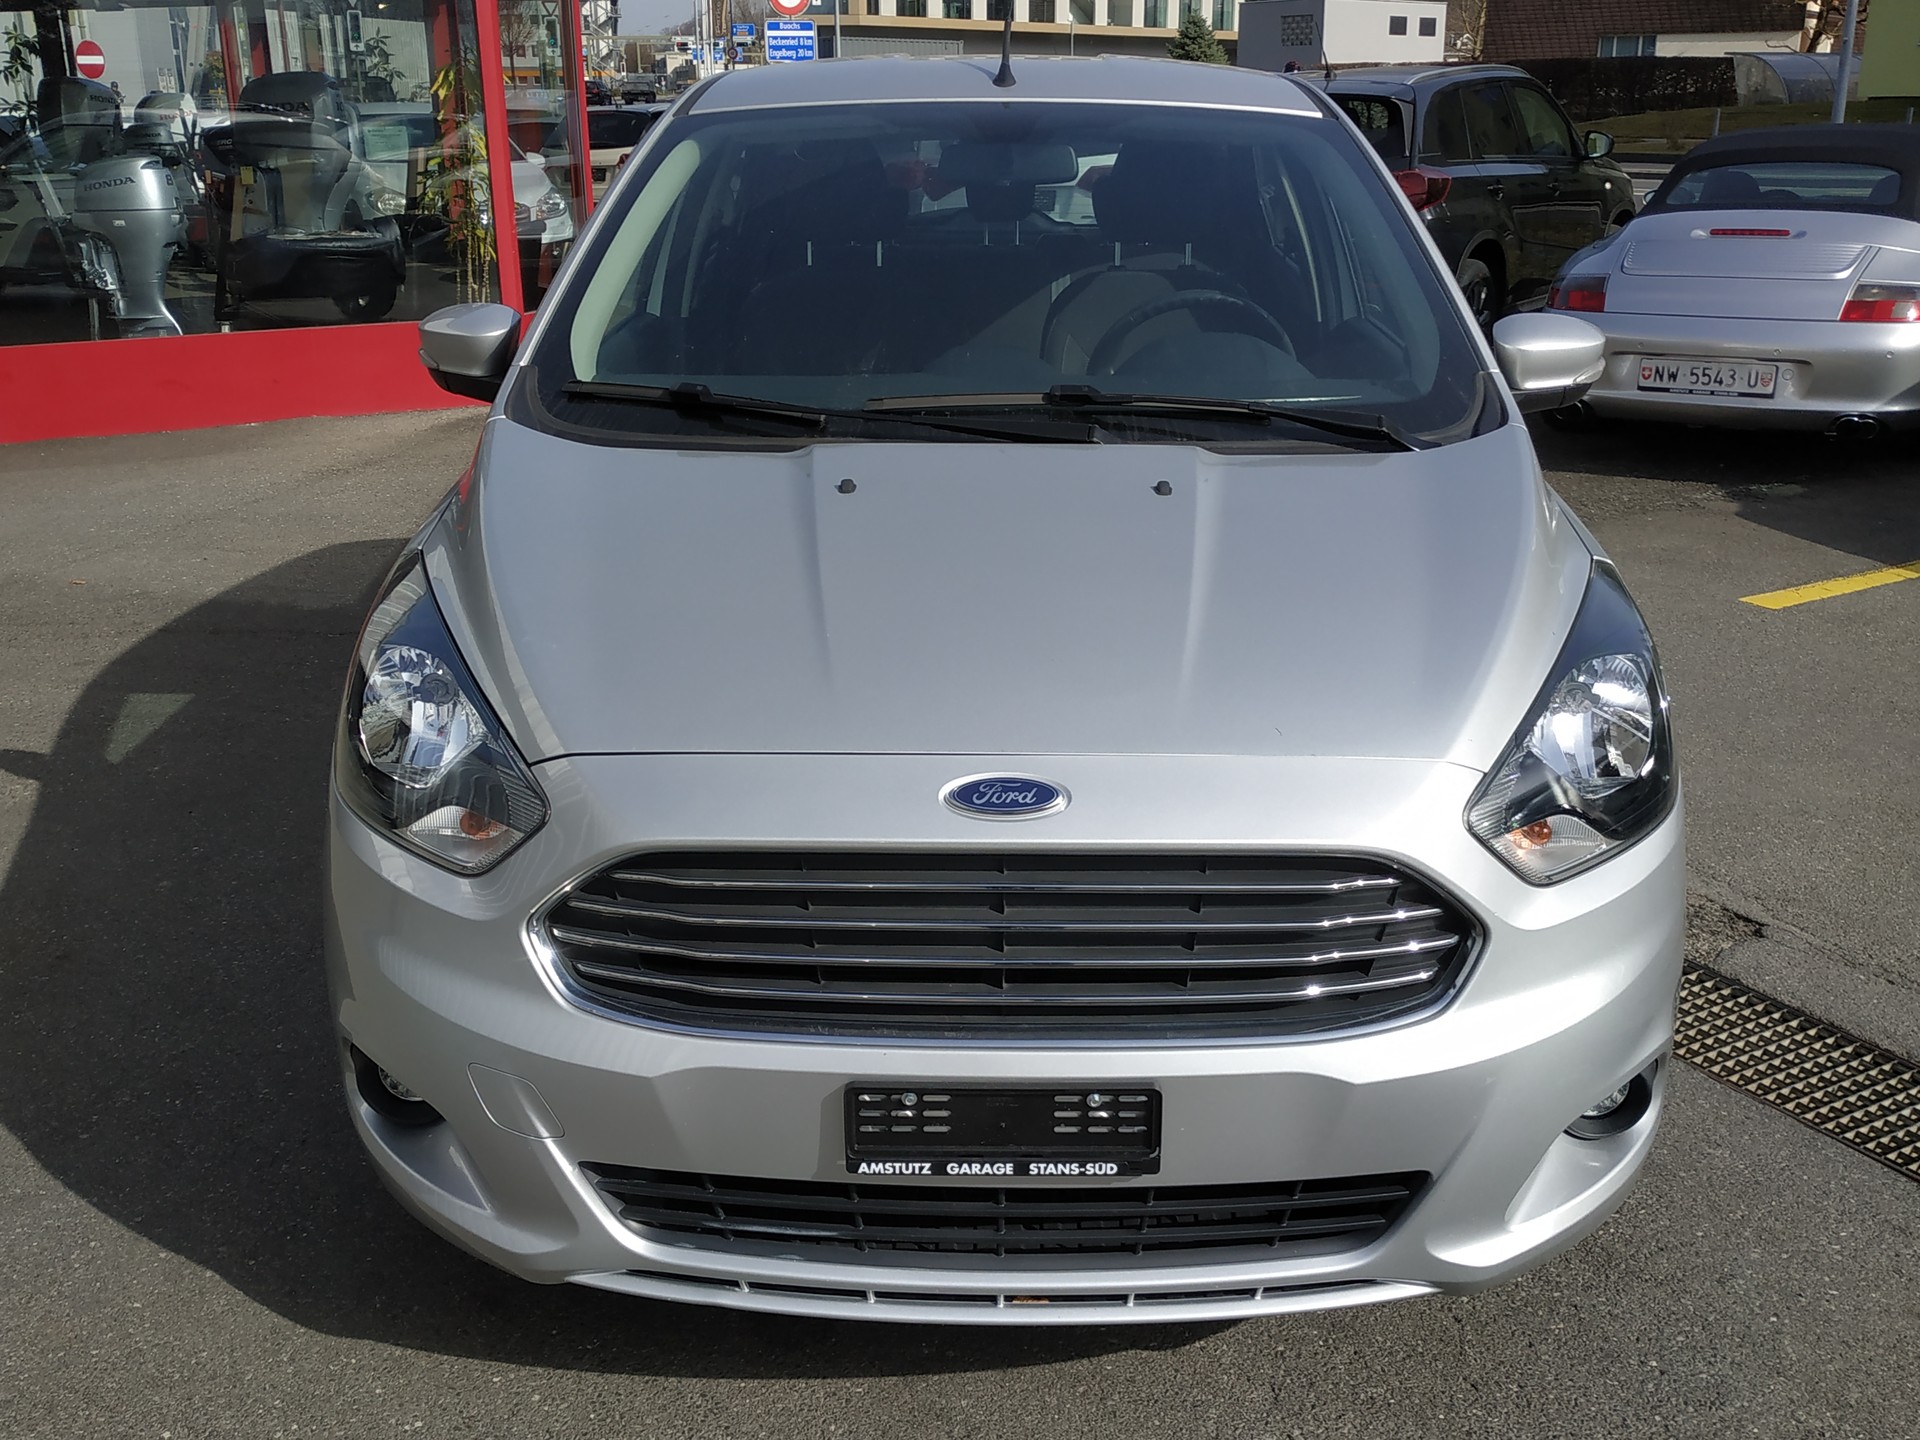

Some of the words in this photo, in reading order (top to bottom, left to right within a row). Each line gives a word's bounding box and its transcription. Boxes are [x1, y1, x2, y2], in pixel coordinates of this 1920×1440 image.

[768, 37, 798, 46] Beckenried
[799, 38, 804, 46] 8
[804, 37, 813, 46] km
[769, 48, 797, 59] Engelberg
[797, 48, 804, 57] 20
[804, 48, 813, 57] km
[89, 95, 119, 104] HOND
[83, 176, 136, 191] HONDA
[1653, 366, 1680, 383] NW
[1689, 366, 1737, 388] 5543
[1747, 369, 1759, 389] U
[972, 781, 1038, 804] Ford
[857, 1162, 932, 1175] AMSTUTZ
[946, 1162, 1014, 1175] GARAGE
[1028, 1161, 1118, 1175] STANS-SÜD
